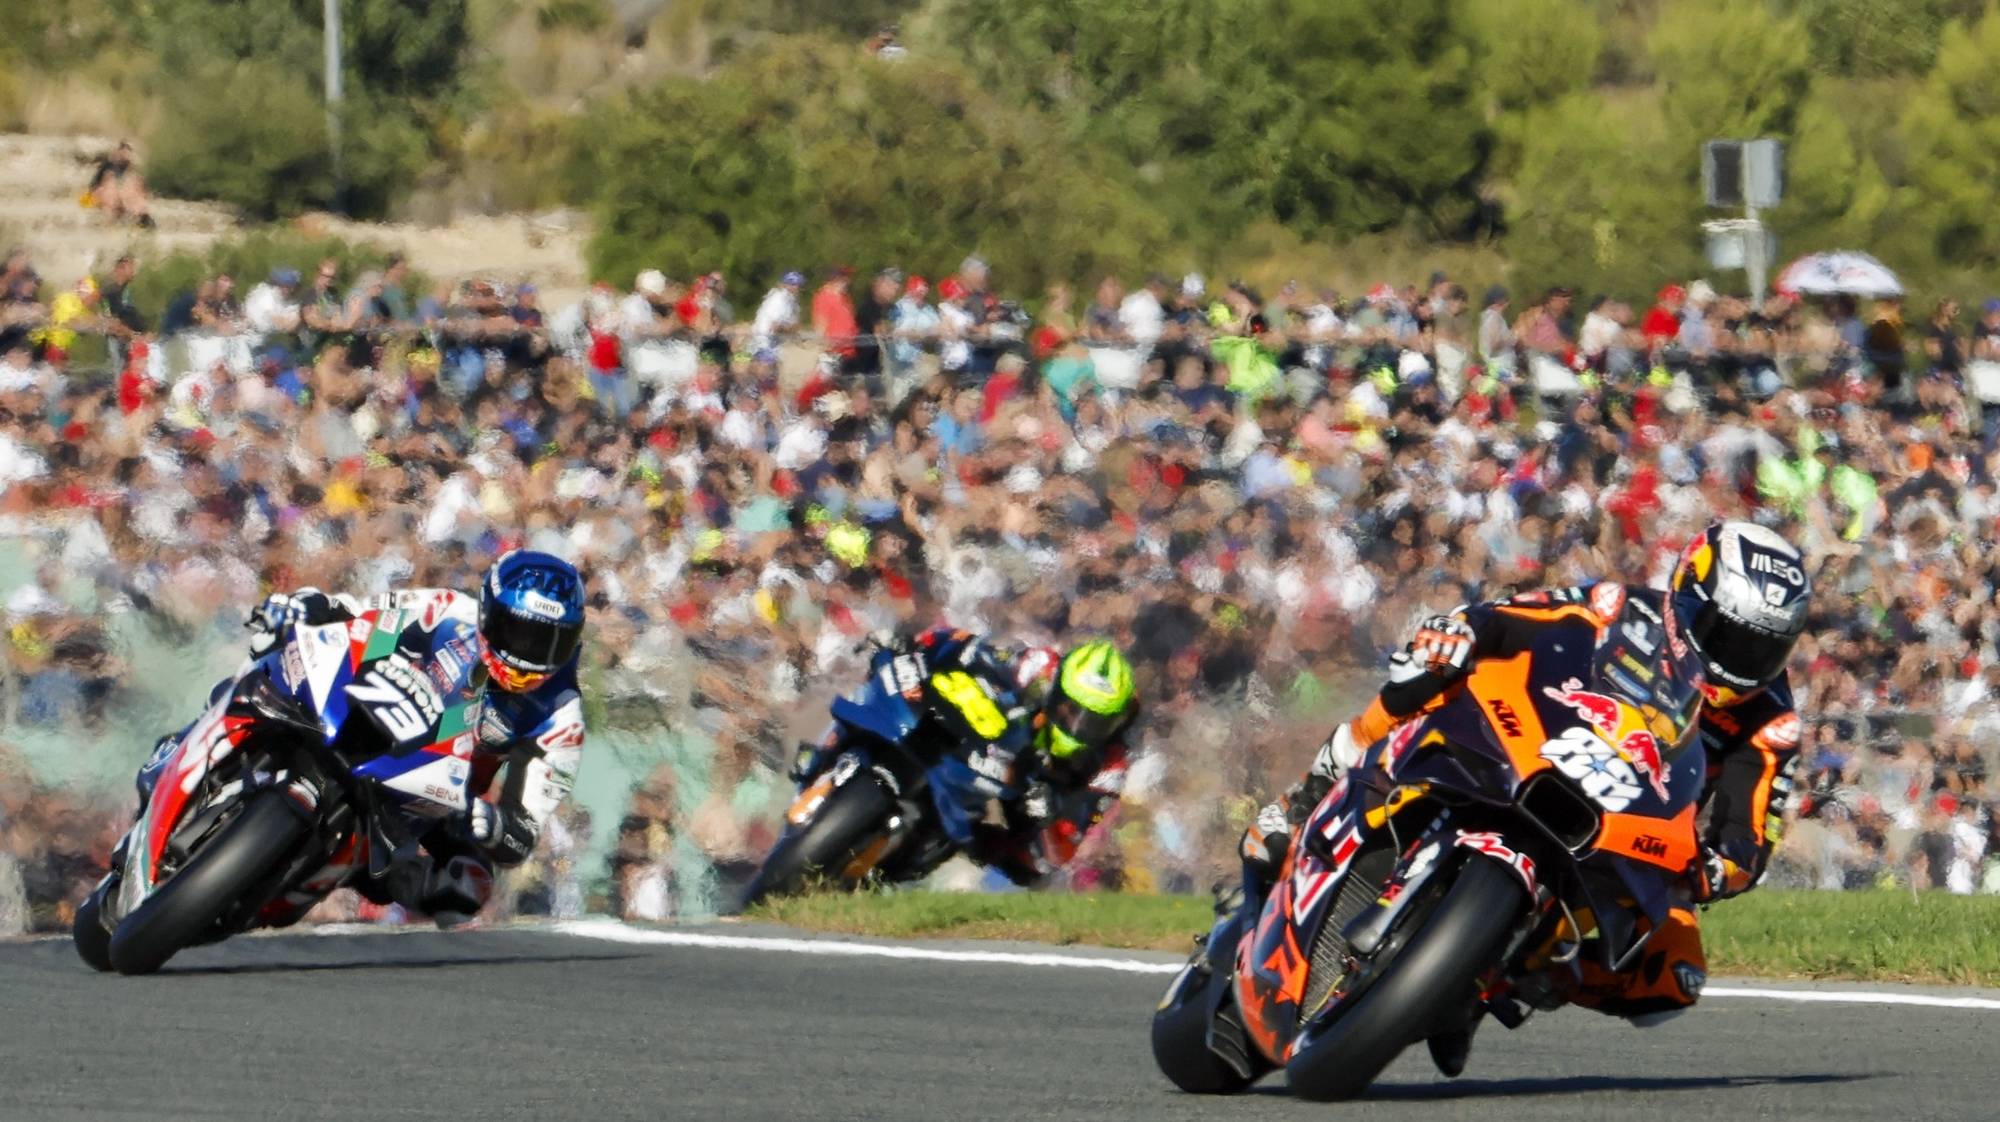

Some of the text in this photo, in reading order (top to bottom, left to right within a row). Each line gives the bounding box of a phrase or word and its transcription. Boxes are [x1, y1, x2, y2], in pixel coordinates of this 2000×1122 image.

[1751, 553, 1804, 586] MEO
[342, 671, 429, 742] 73
[1488, 699, 1523, 738] KTM
[1540, 727, 1645, 812] 88
[424, 784, 460, 803] SENA
[1631, 834, 1668, 859] KTM
